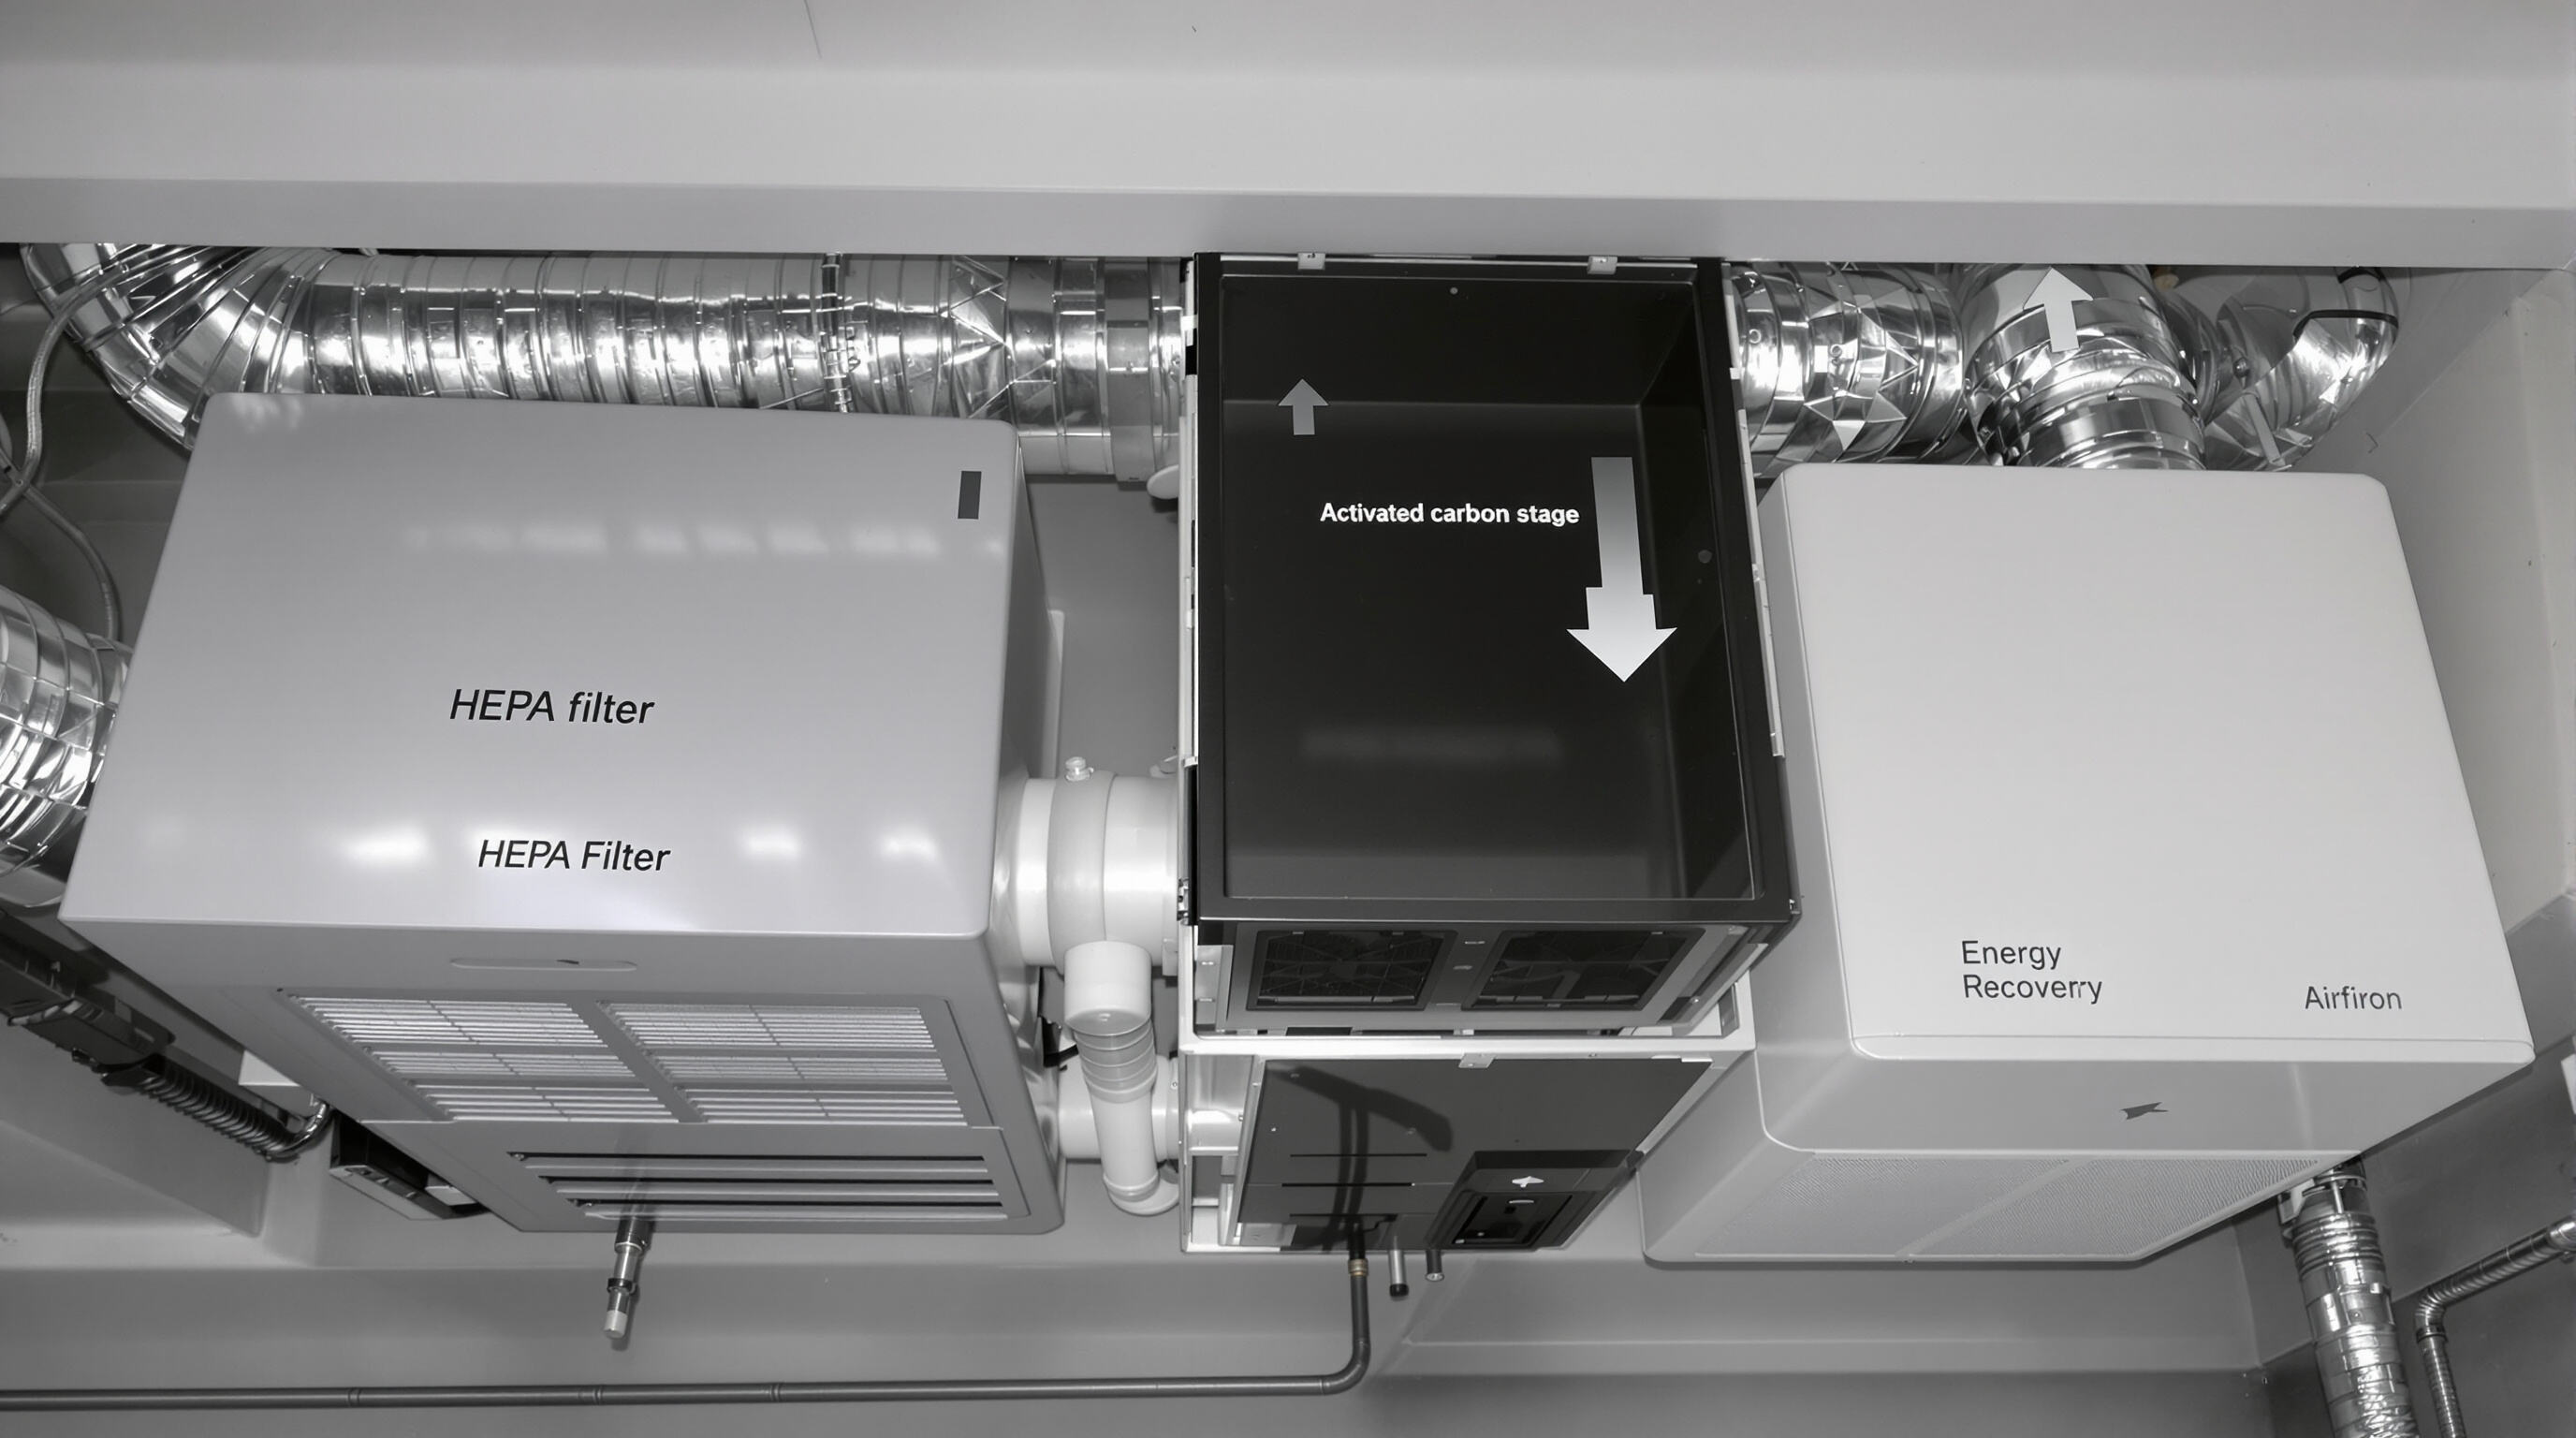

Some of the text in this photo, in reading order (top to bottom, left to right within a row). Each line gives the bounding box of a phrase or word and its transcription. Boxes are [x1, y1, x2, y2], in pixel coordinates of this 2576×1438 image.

[1319, 502, 1580, 527] Activated carbon stage
[449, 688, 656, 725] HEPA filter
[477, 839, 672, 872] HEPA Filter
[1961, 940, 2062, 971] Energy
[2305, 985, 2403, 1010] Airfiron
